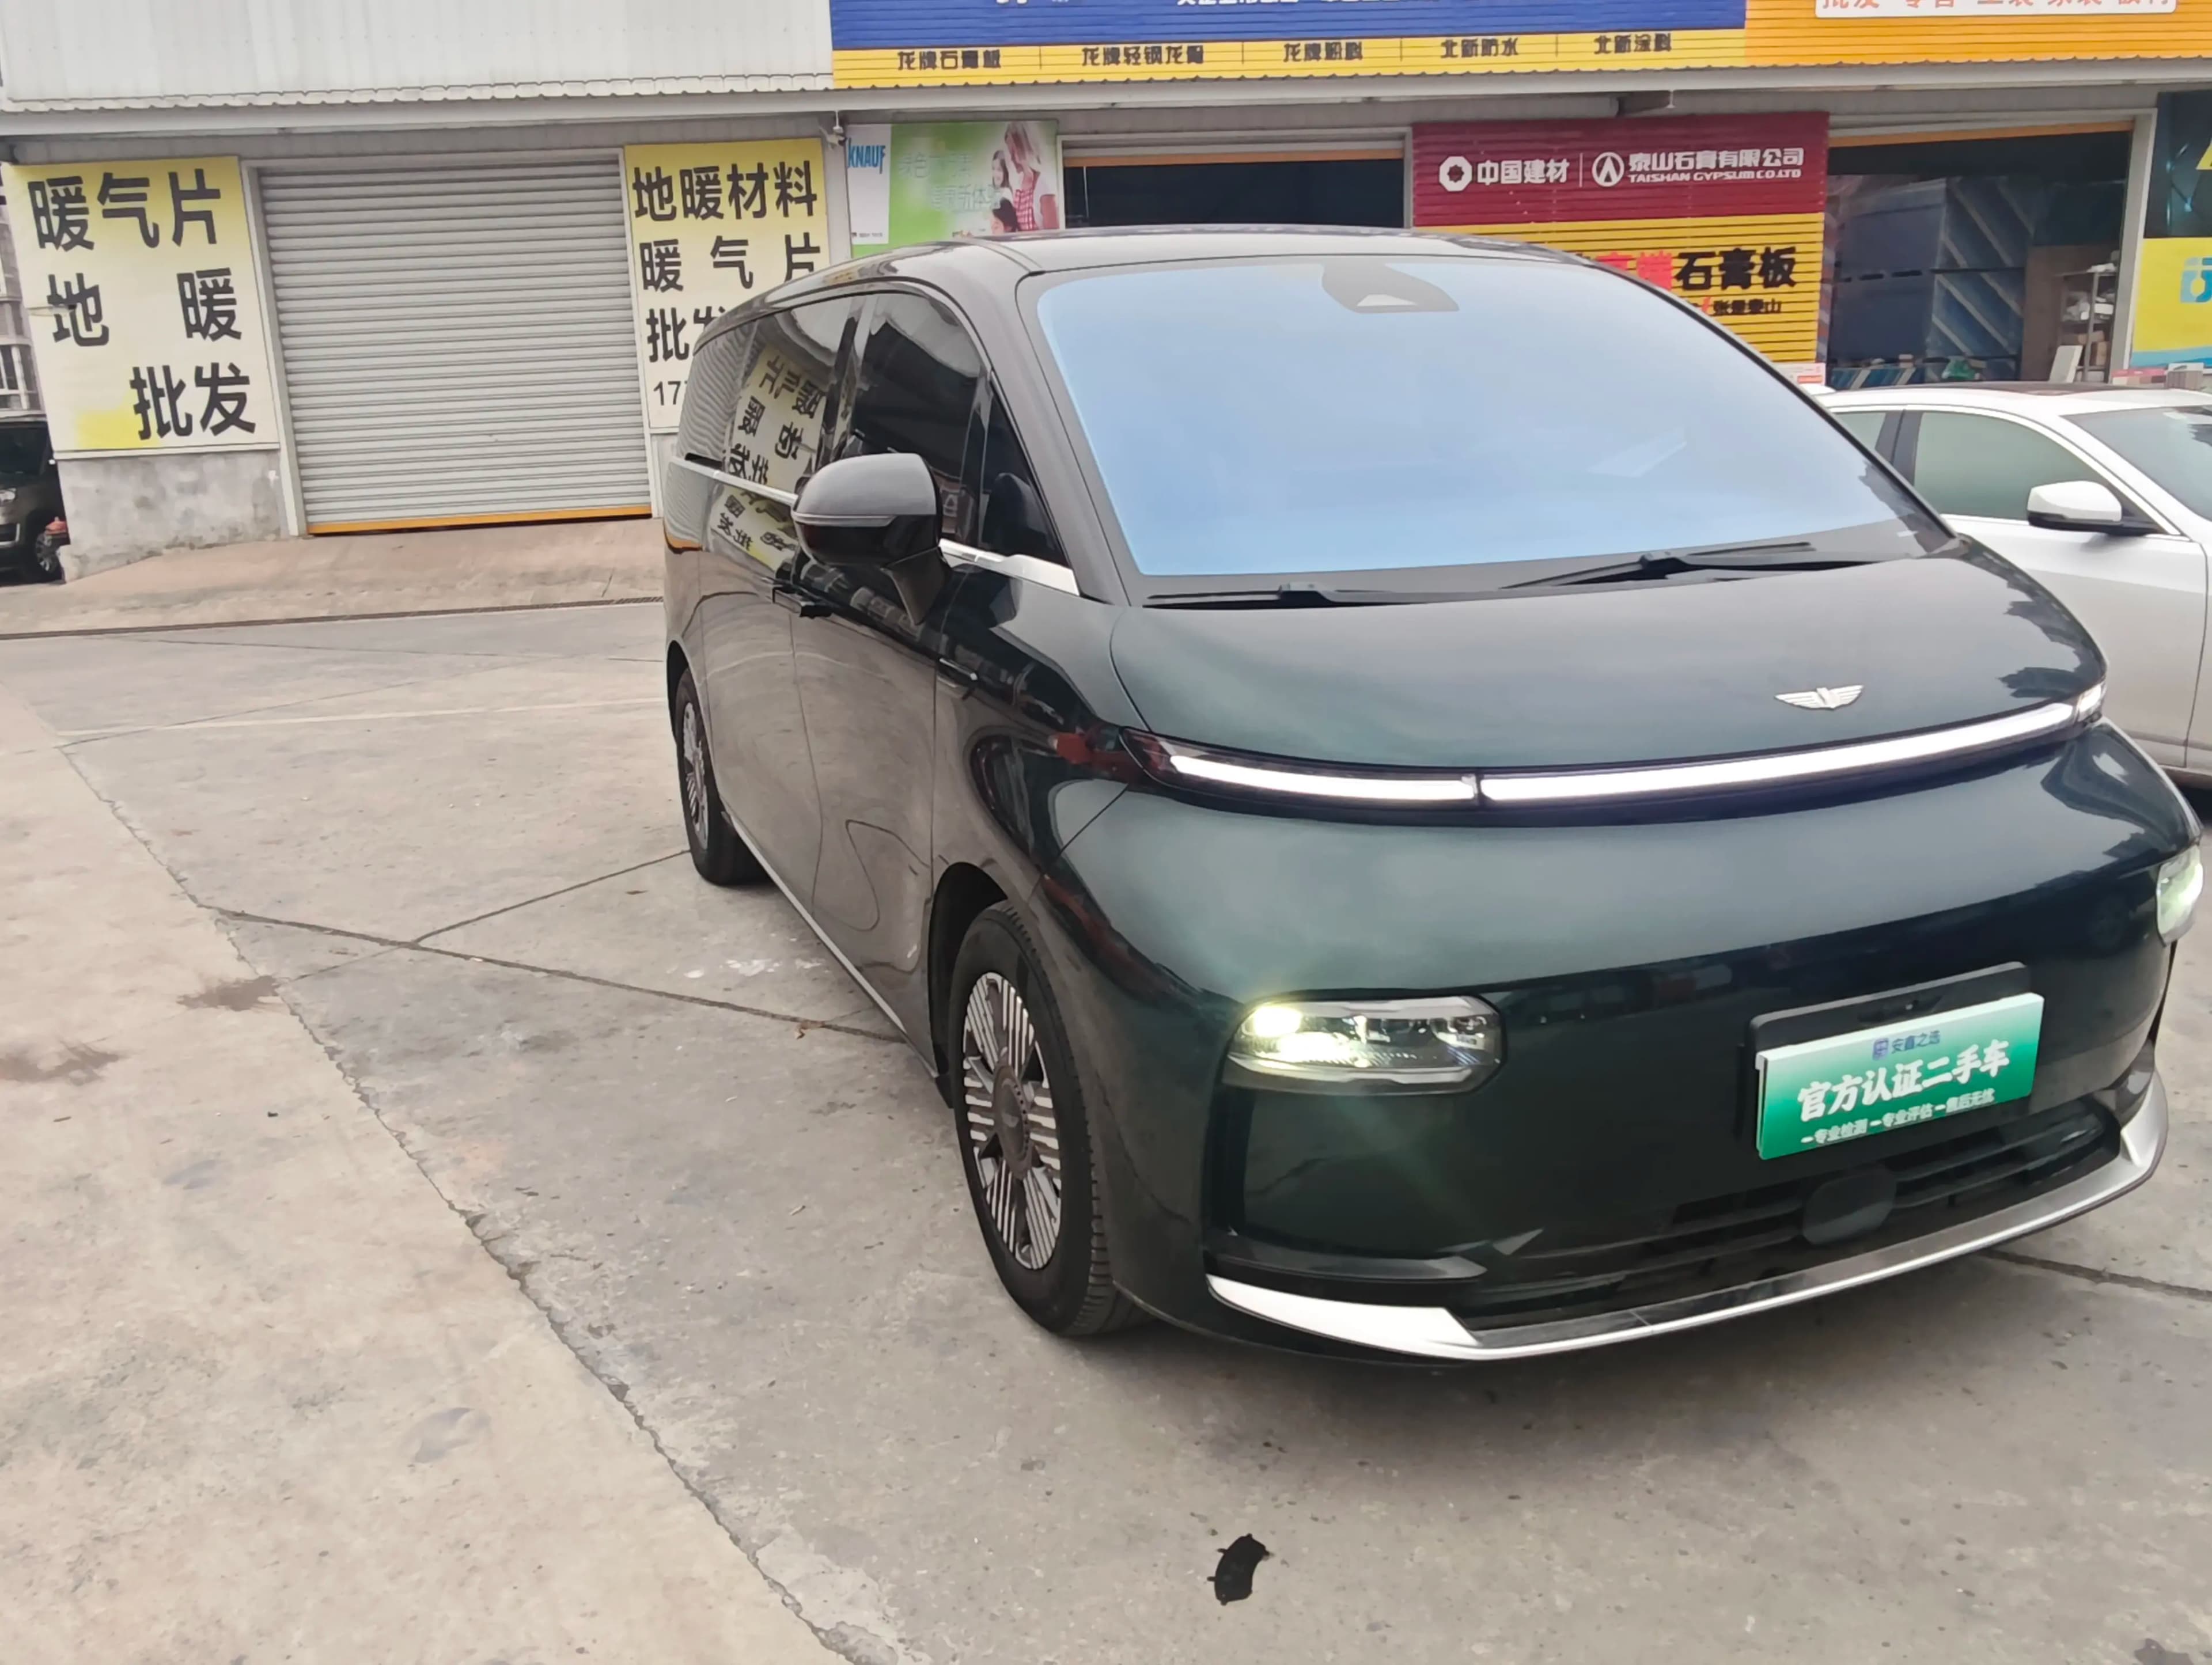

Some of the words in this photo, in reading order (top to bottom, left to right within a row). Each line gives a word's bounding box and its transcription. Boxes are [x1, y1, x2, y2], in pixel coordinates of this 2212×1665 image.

[849, 137, 886, 174] KNAUF
[1477, 160, 1570, 186] 中国建材
[1628, 172, 1690, 183] TAISHAN
[1629, 147, 1804, 172] 泰山石膏有限公司
[28, 168, 221, 252] 暖气片
[632, 160, 817, 222] 地暖材料
[639, 232, 821, 293] 暖气片
[130, 362, 256, 440] 批发
[653, 381, 688, 406] 17
[1797, 1039, 2010, 1122] 官方认证二手车
